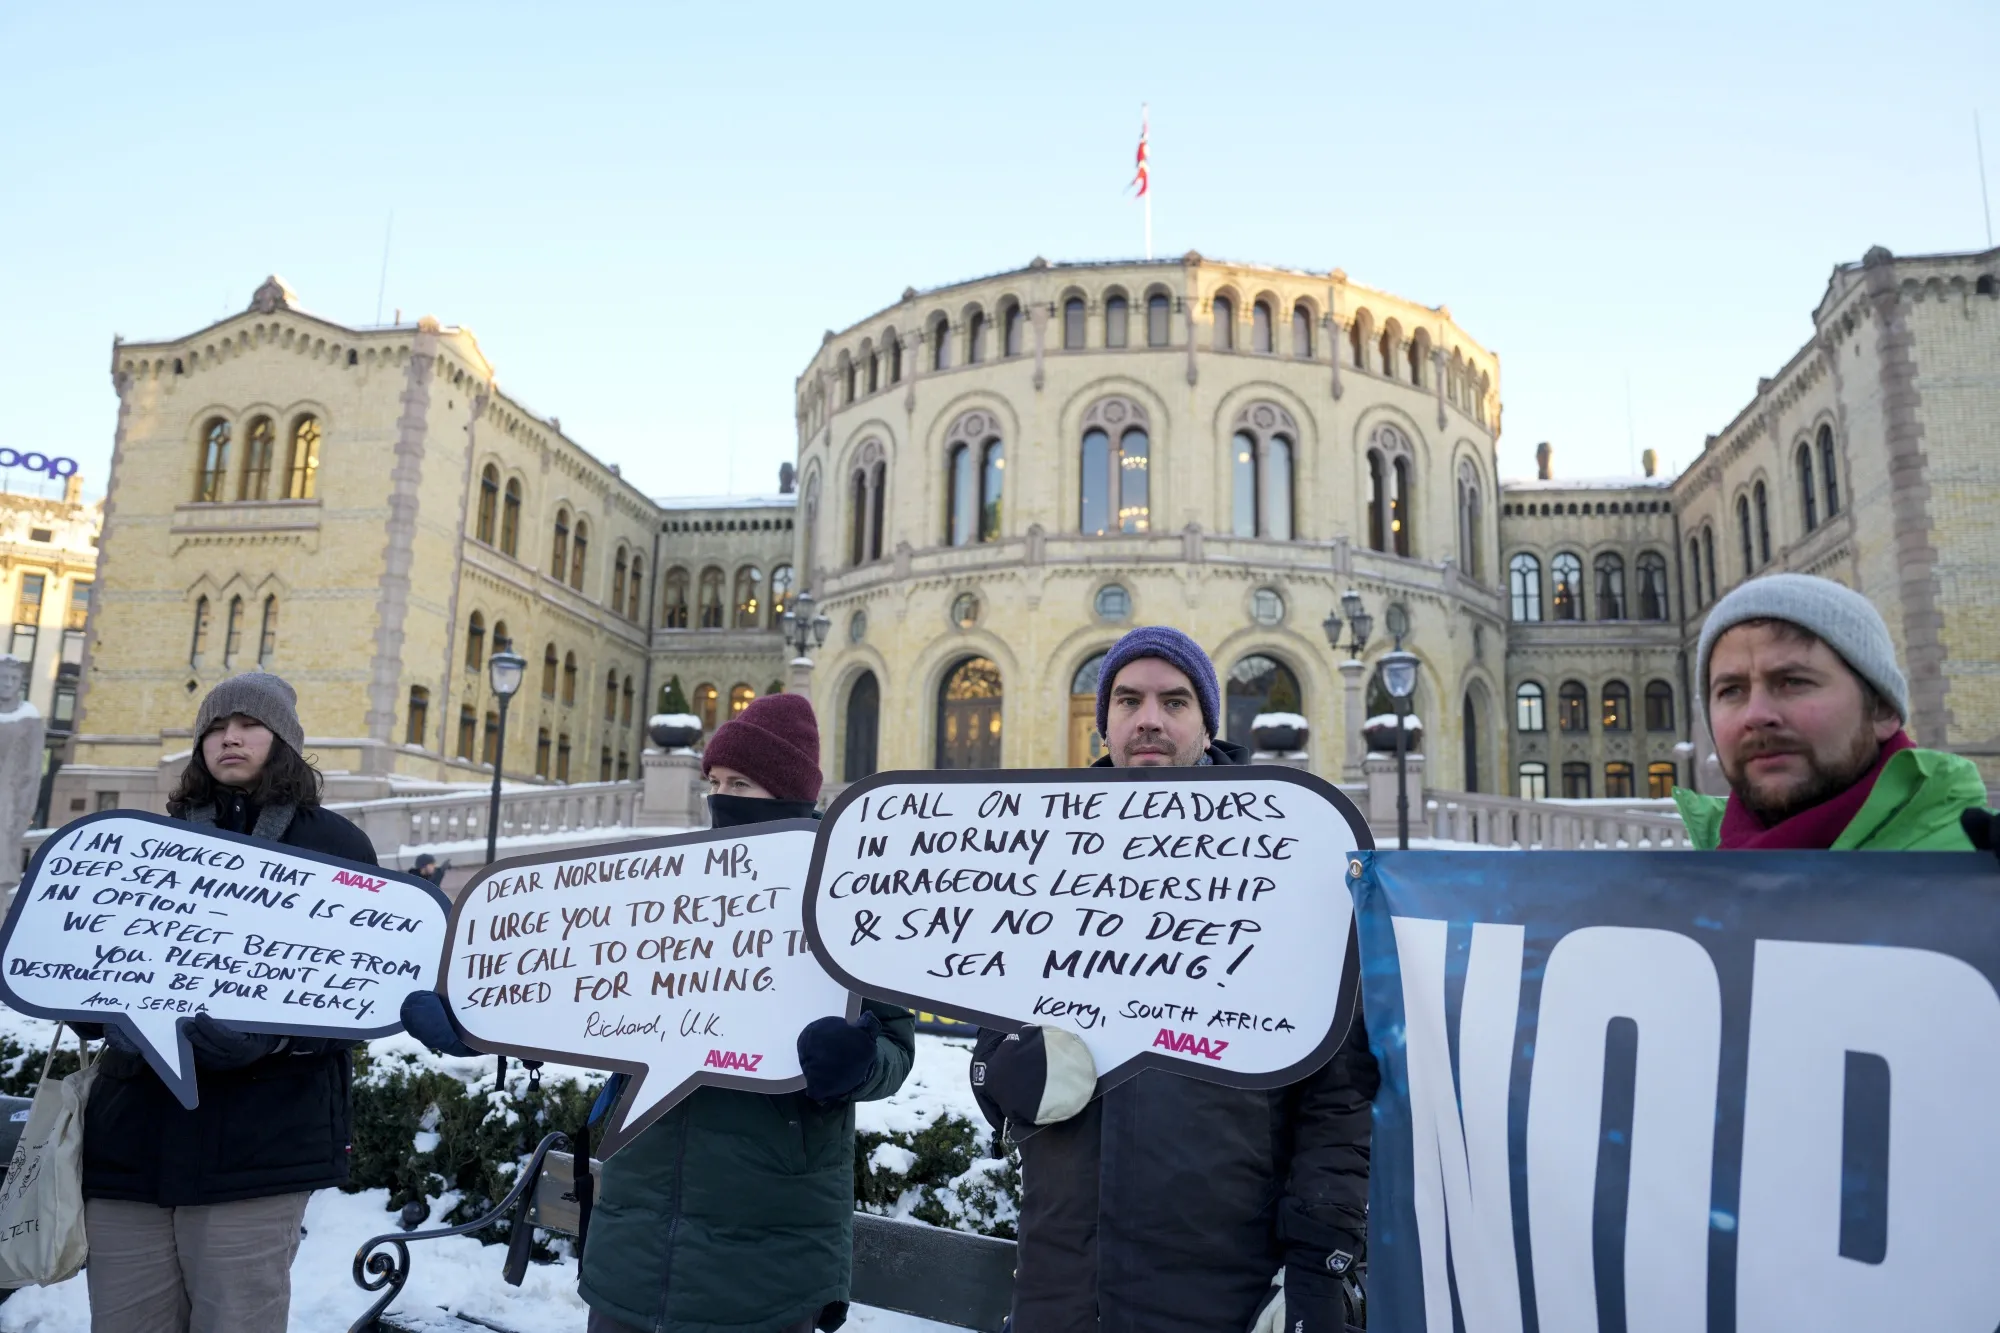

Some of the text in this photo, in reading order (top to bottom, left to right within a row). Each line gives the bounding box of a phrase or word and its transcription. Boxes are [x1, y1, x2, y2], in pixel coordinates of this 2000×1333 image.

[861, 791, 1285, 822] I CALL ON THE LEADERS
[69, 830, 316, 886] I AM SHOCKED THAT
[858, 827, 1299, 865] IN NORWAY TO EXERCISE
[332, 871, 387, 893] AVAAZ
[487, 844, 757, 903] DEAR NORWEGIAN MPs,
[829, 869, 1275, 901] COURAGEOUS LEADERSHIP
[38, 884, 80, 901] AN
[93, 888, 197, 914] OPTION
[49, 857, 423, 933] DEEP SEA MINING IS EVEN
[468, 887, 790, 945] I URGE YOU TO REJECT
[850, 907, 1261, 946] & SAY NO TO DEEP
[64, 912, 421, 980] WE EXPECT BETTER FROM
[461, 952, 512, 980] THE
[517, 947, 576, 975] CALL
[590, 941, 626, 965] TO
[637, 936, 713, 963] OPEN
[733, 929, 773, 958] UP
[927, 944, 1254, 987] SEA MINING!
[92, 945, 379, 991] YOU. PLEASE DON'T LET
[9, 958, 374, 1020] DESTRUCTION BE YOUR LEGACY.
[137, 996, 208, 1013] SERBIA
[461, 967, 775, 1010] SEABED FOR MINING.
[584, 1009, 724, 1042] Richard, U.K.
[1033, 996, 1295, 1033] Kerry, SOUTH AFRICA
[704, 1050, 763, 1072] AVAAZ
[1152, 1028, 1229, 1060] AVAAZ
